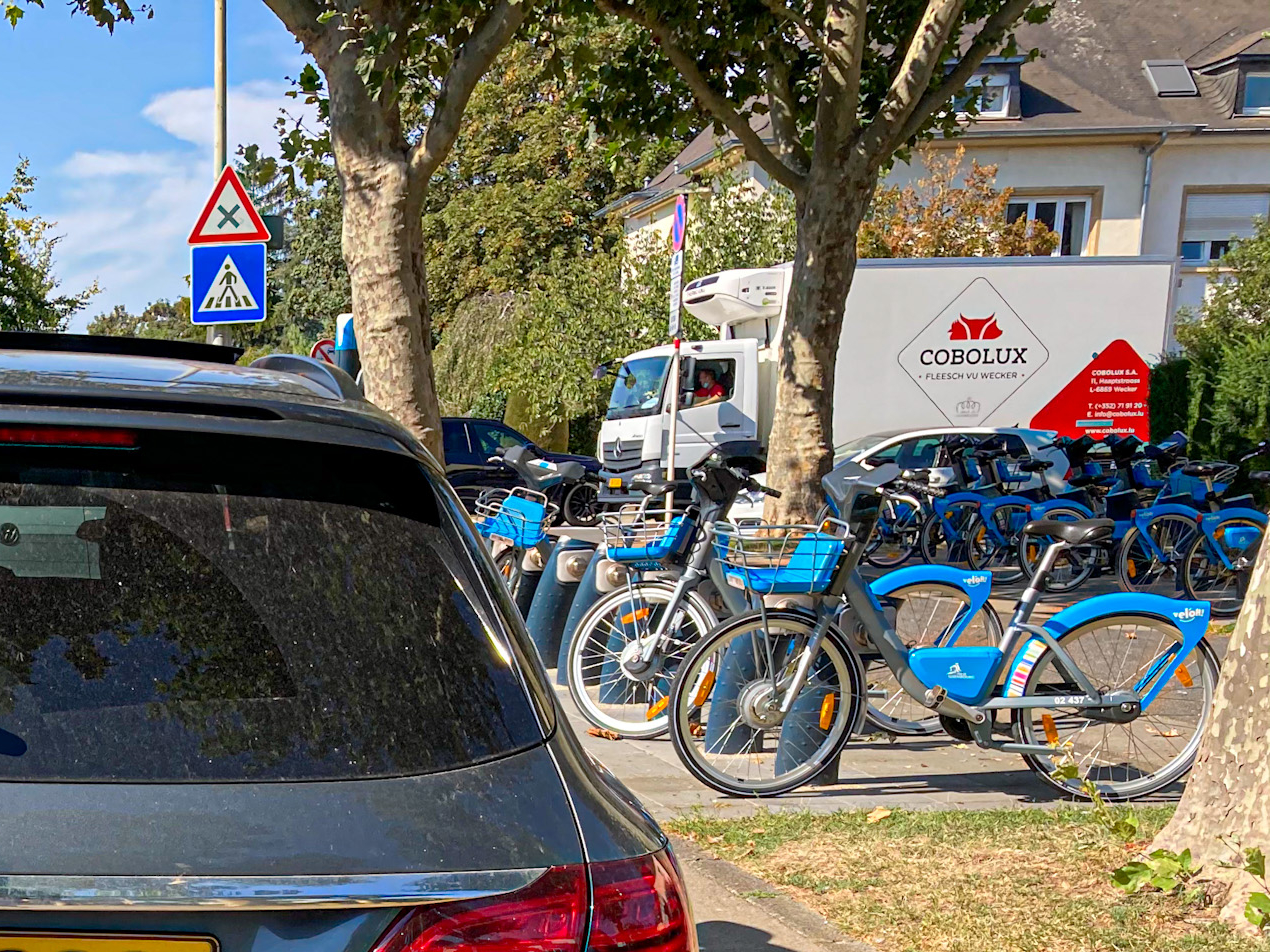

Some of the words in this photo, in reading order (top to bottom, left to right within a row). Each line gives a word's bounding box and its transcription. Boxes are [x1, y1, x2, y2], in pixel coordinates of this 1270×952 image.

[920, 348, 1028, 366] COBOLUX
[966, 372, 979, 380] VU
[981, 372, 1018, 380] WECKER
[1054, 696, 1066, 705] 02
[1067, 696, 1085, 705] 437
